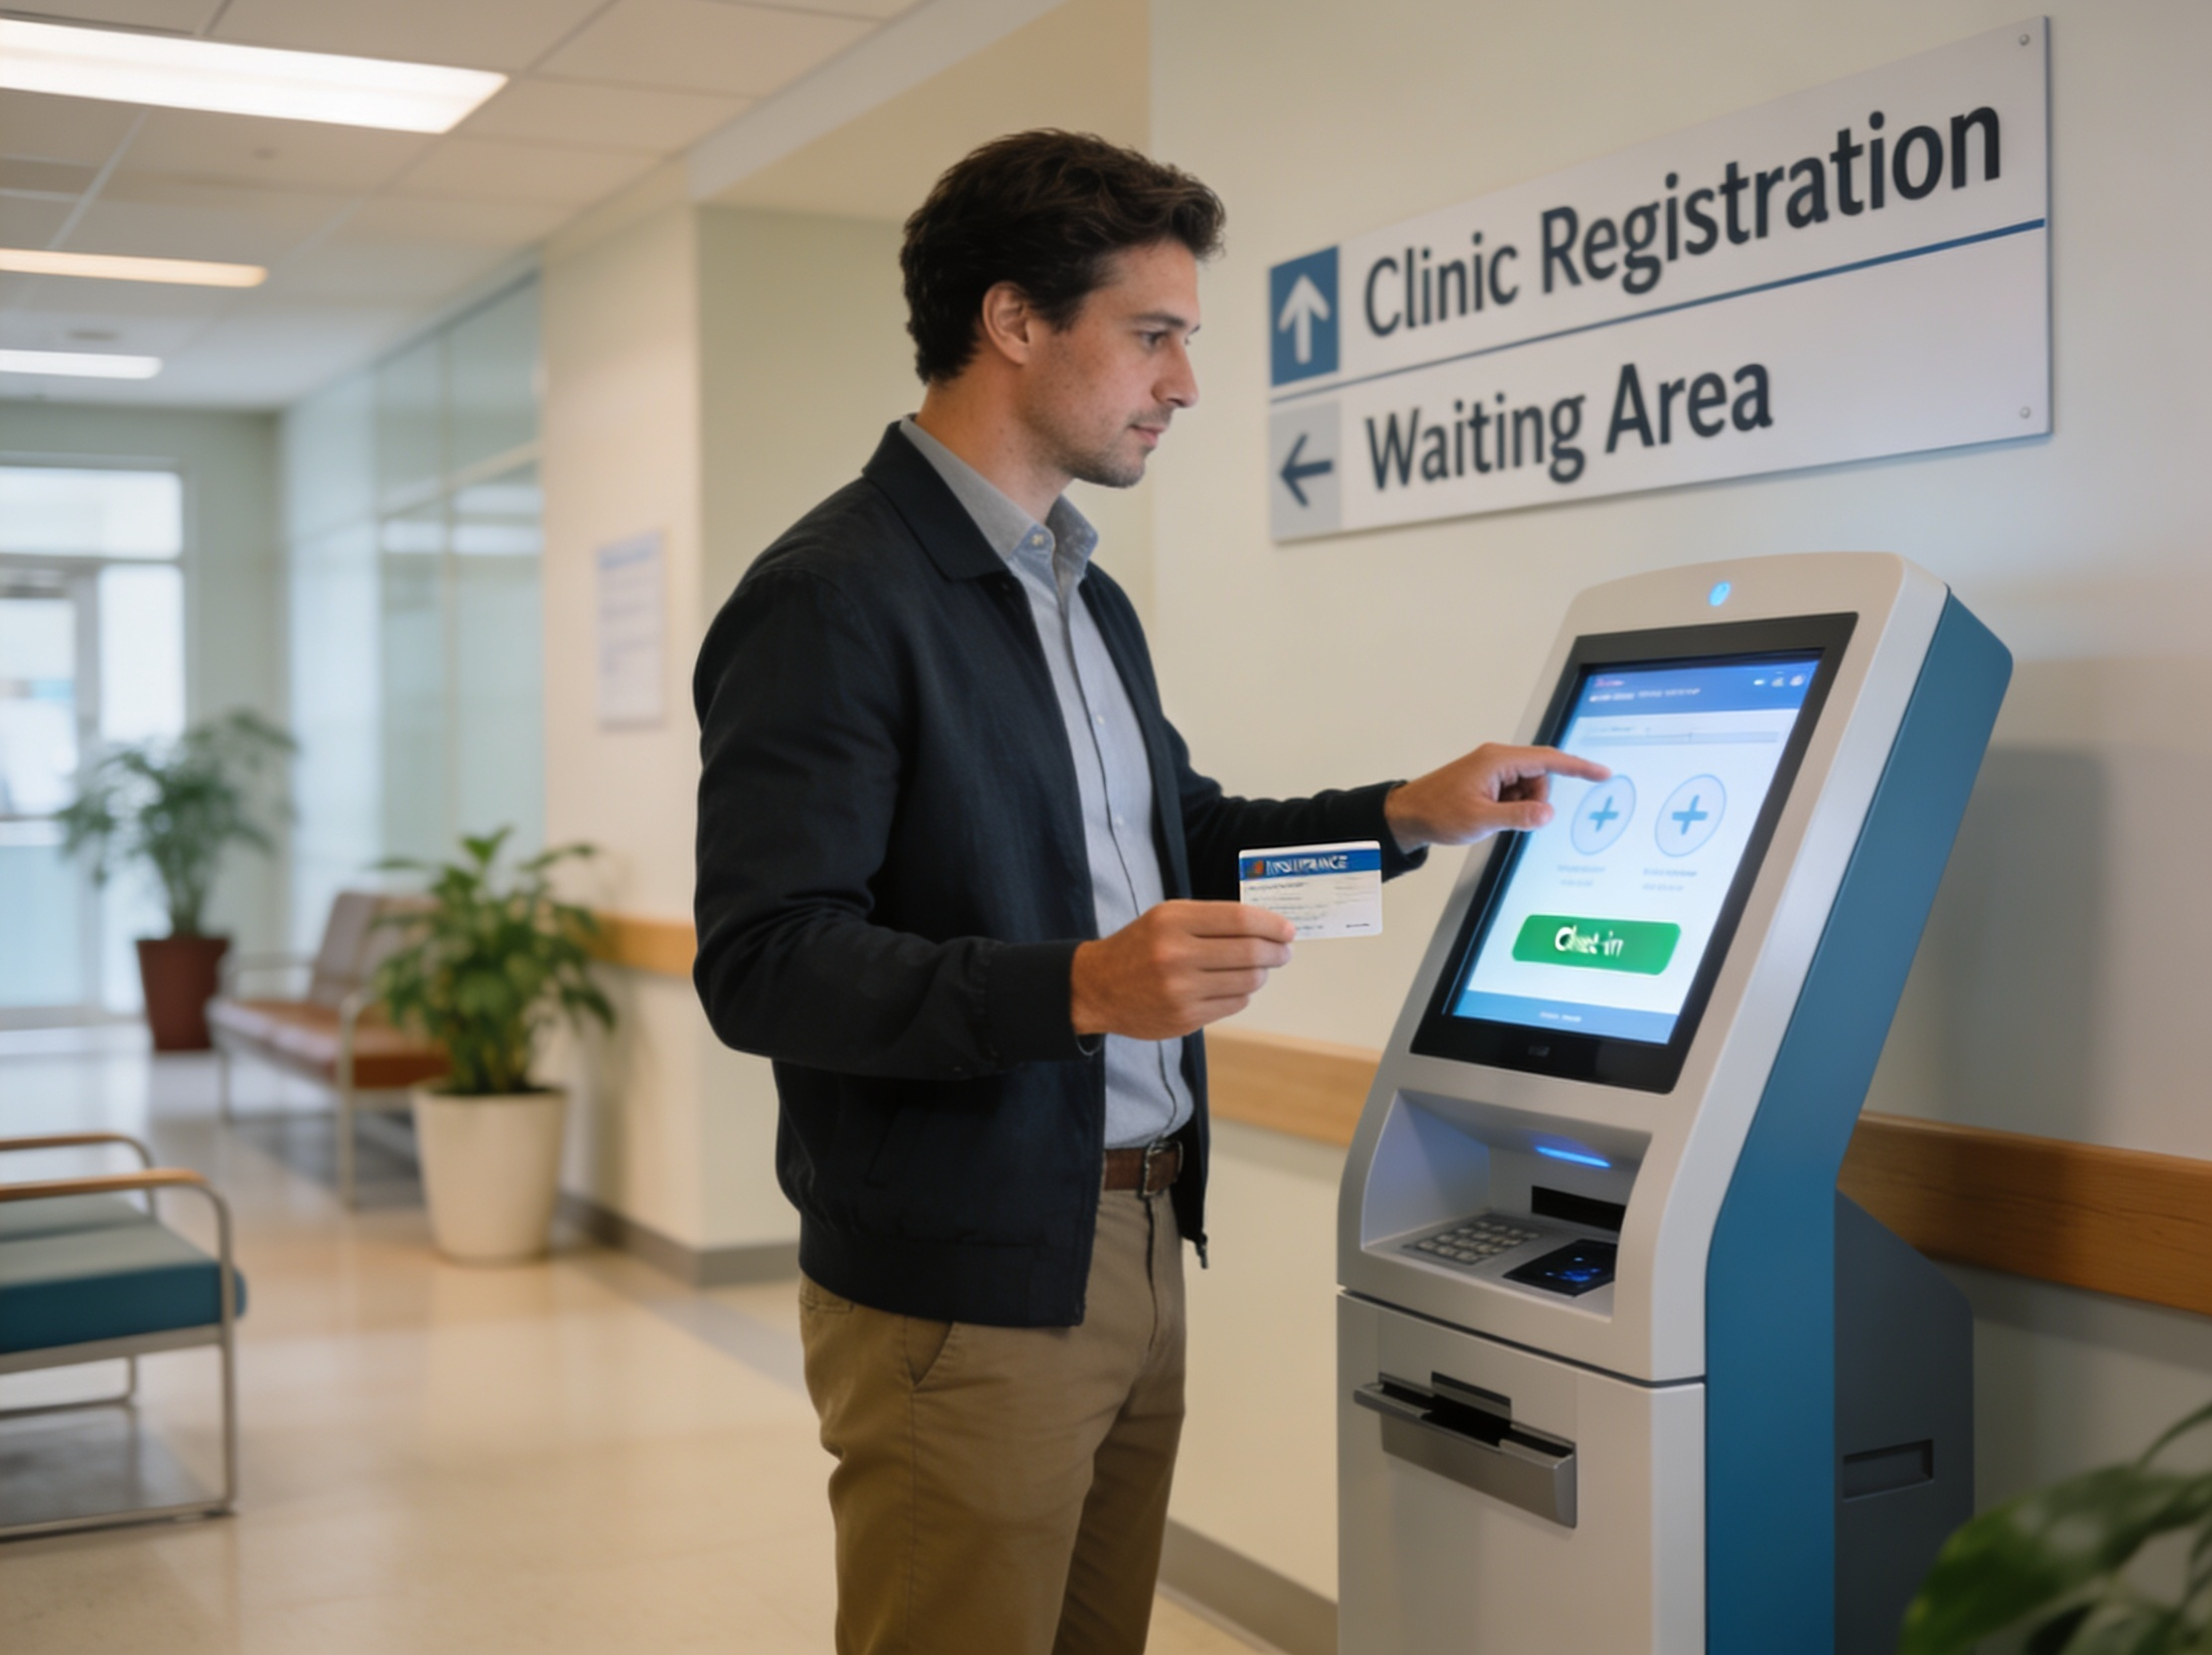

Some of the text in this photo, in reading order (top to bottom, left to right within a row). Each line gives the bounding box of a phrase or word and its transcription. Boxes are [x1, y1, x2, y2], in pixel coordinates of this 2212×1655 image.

[1364, 104, 2002, 338] Clinic Registration
[1365, 361, 1774, 490] Waiting Area
